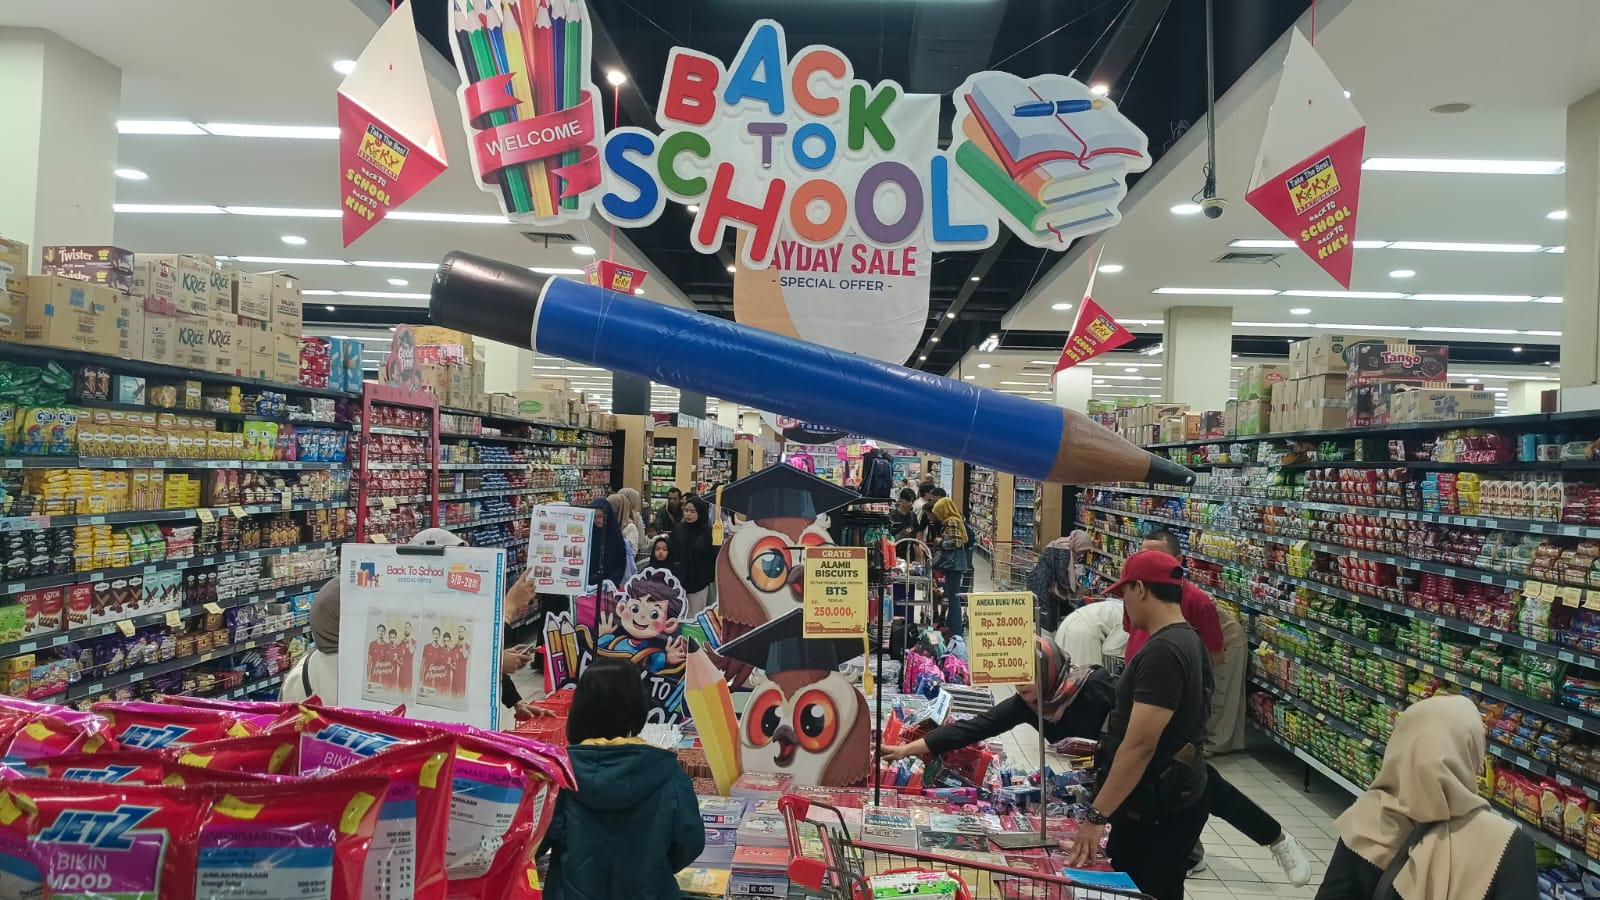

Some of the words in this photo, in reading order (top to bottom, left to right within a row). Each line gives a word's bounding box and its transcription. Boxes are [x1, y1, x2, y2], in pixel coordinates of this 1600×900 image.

[664, 25, 896, 150] BACK
[370, 126, 383, 140] Take
[383, 134, 394, 147] The
[393, 141, 407, 156] Best
[486, 120, 583, 156] WELCOME
[748, 122, 836, 170] TO
[361, 167, 378, 181] BACK
[1290, 175, 1304, 188] Take
[1304, 167, 1316, 179] The
[1316, 160, 1330, 174] Best
[346, 169, 391, 207] SCHOOL
[602, 131, 988, 261] SCHOOL
[345, 196, 375, 221] KIKY
[1309, 207, 1327, 221] BACK
[1301, 206, 1351, 242] SCHOOL
[59, 249, 93, 263] Twister
[1318, 233, 1349, 259] KIKY
[770, 240, 844, 273] AYDAY
[851, 243, 917, 277] SALE
[780, 277, 836, 290] SPECIAL
[840, 279, 884, 291] OFFER
[1381, 351, 1421, 369] Tango
[822, 550, 851, 558] GRATIS
[387, 565, 406, 576] Back
[408, 565, 417, 576] To
[419, 565, 444, 577] School
[826, 587, 847, 595] BTS
[814, 607, 856, 618] 250.000,-
[1011, 598, 1026, 606] PACK
[981, 618, 994, 629] Rp.
[996, 617, 1028, 628] 28.000,-
[982, 638, 995, 649] Rp.
[997, 637, 1027, 647] 41.500,-
[983, 659, 996, 670] Rp.
[998, 658, 1027, 668] 51.000,-
[650, 677, 670, 700] TO
[117, 724, 196, 749] JETZ
[315, 724, 402, 758] JETZ
[39, 804, 161, 851] JETZ
[54, 852, 107, 870] BIKIN
[47, 872, 111, 891] MOOD
